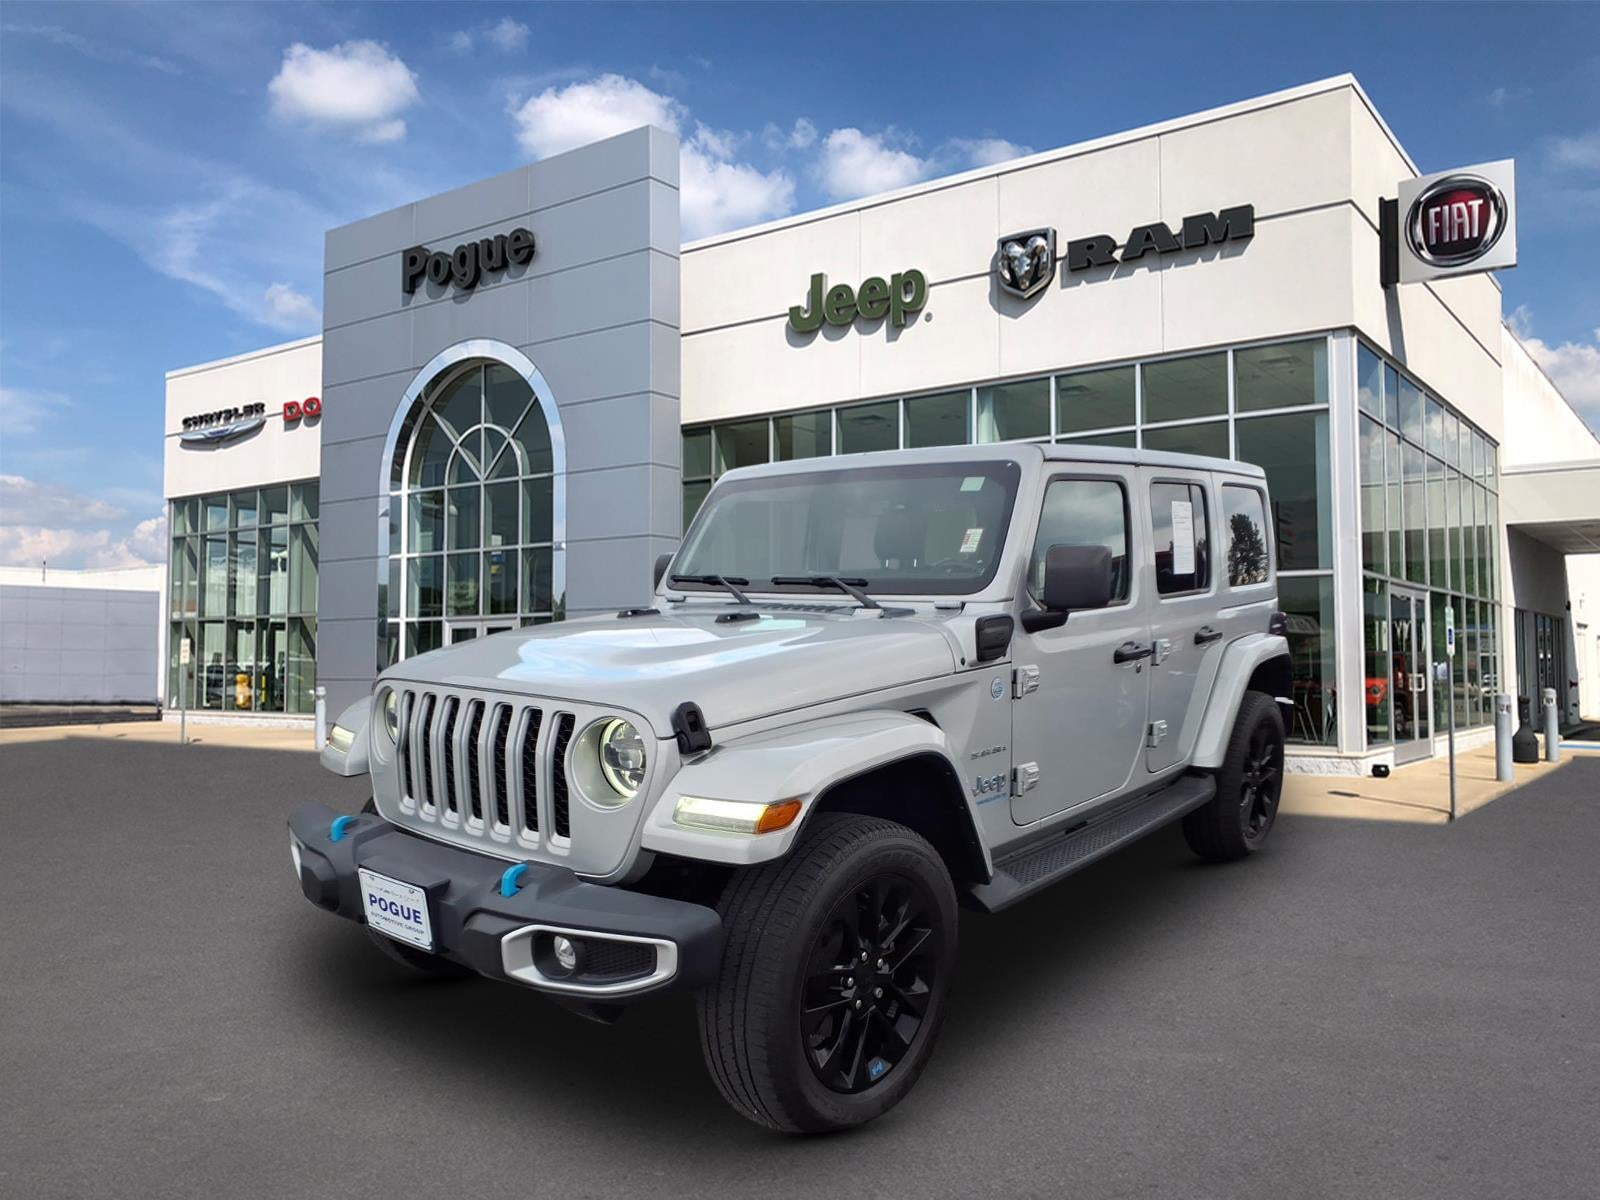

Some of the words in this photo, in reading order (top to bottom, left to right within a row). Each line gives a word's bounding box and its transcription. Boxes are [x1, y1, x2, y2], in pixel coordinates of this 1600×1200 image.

[1067, 204, 1255, 271] RAM
[1428, 199, 1484, 246] FIAT
[402, 227, 535, 294] Pogue
[788, 268, 930, 332] Jeep
[182, 402, 265, 429] CHRYSLER
[971, 774, 1007, 797] Jeep
[368, 893, 423, 925] POGUE
